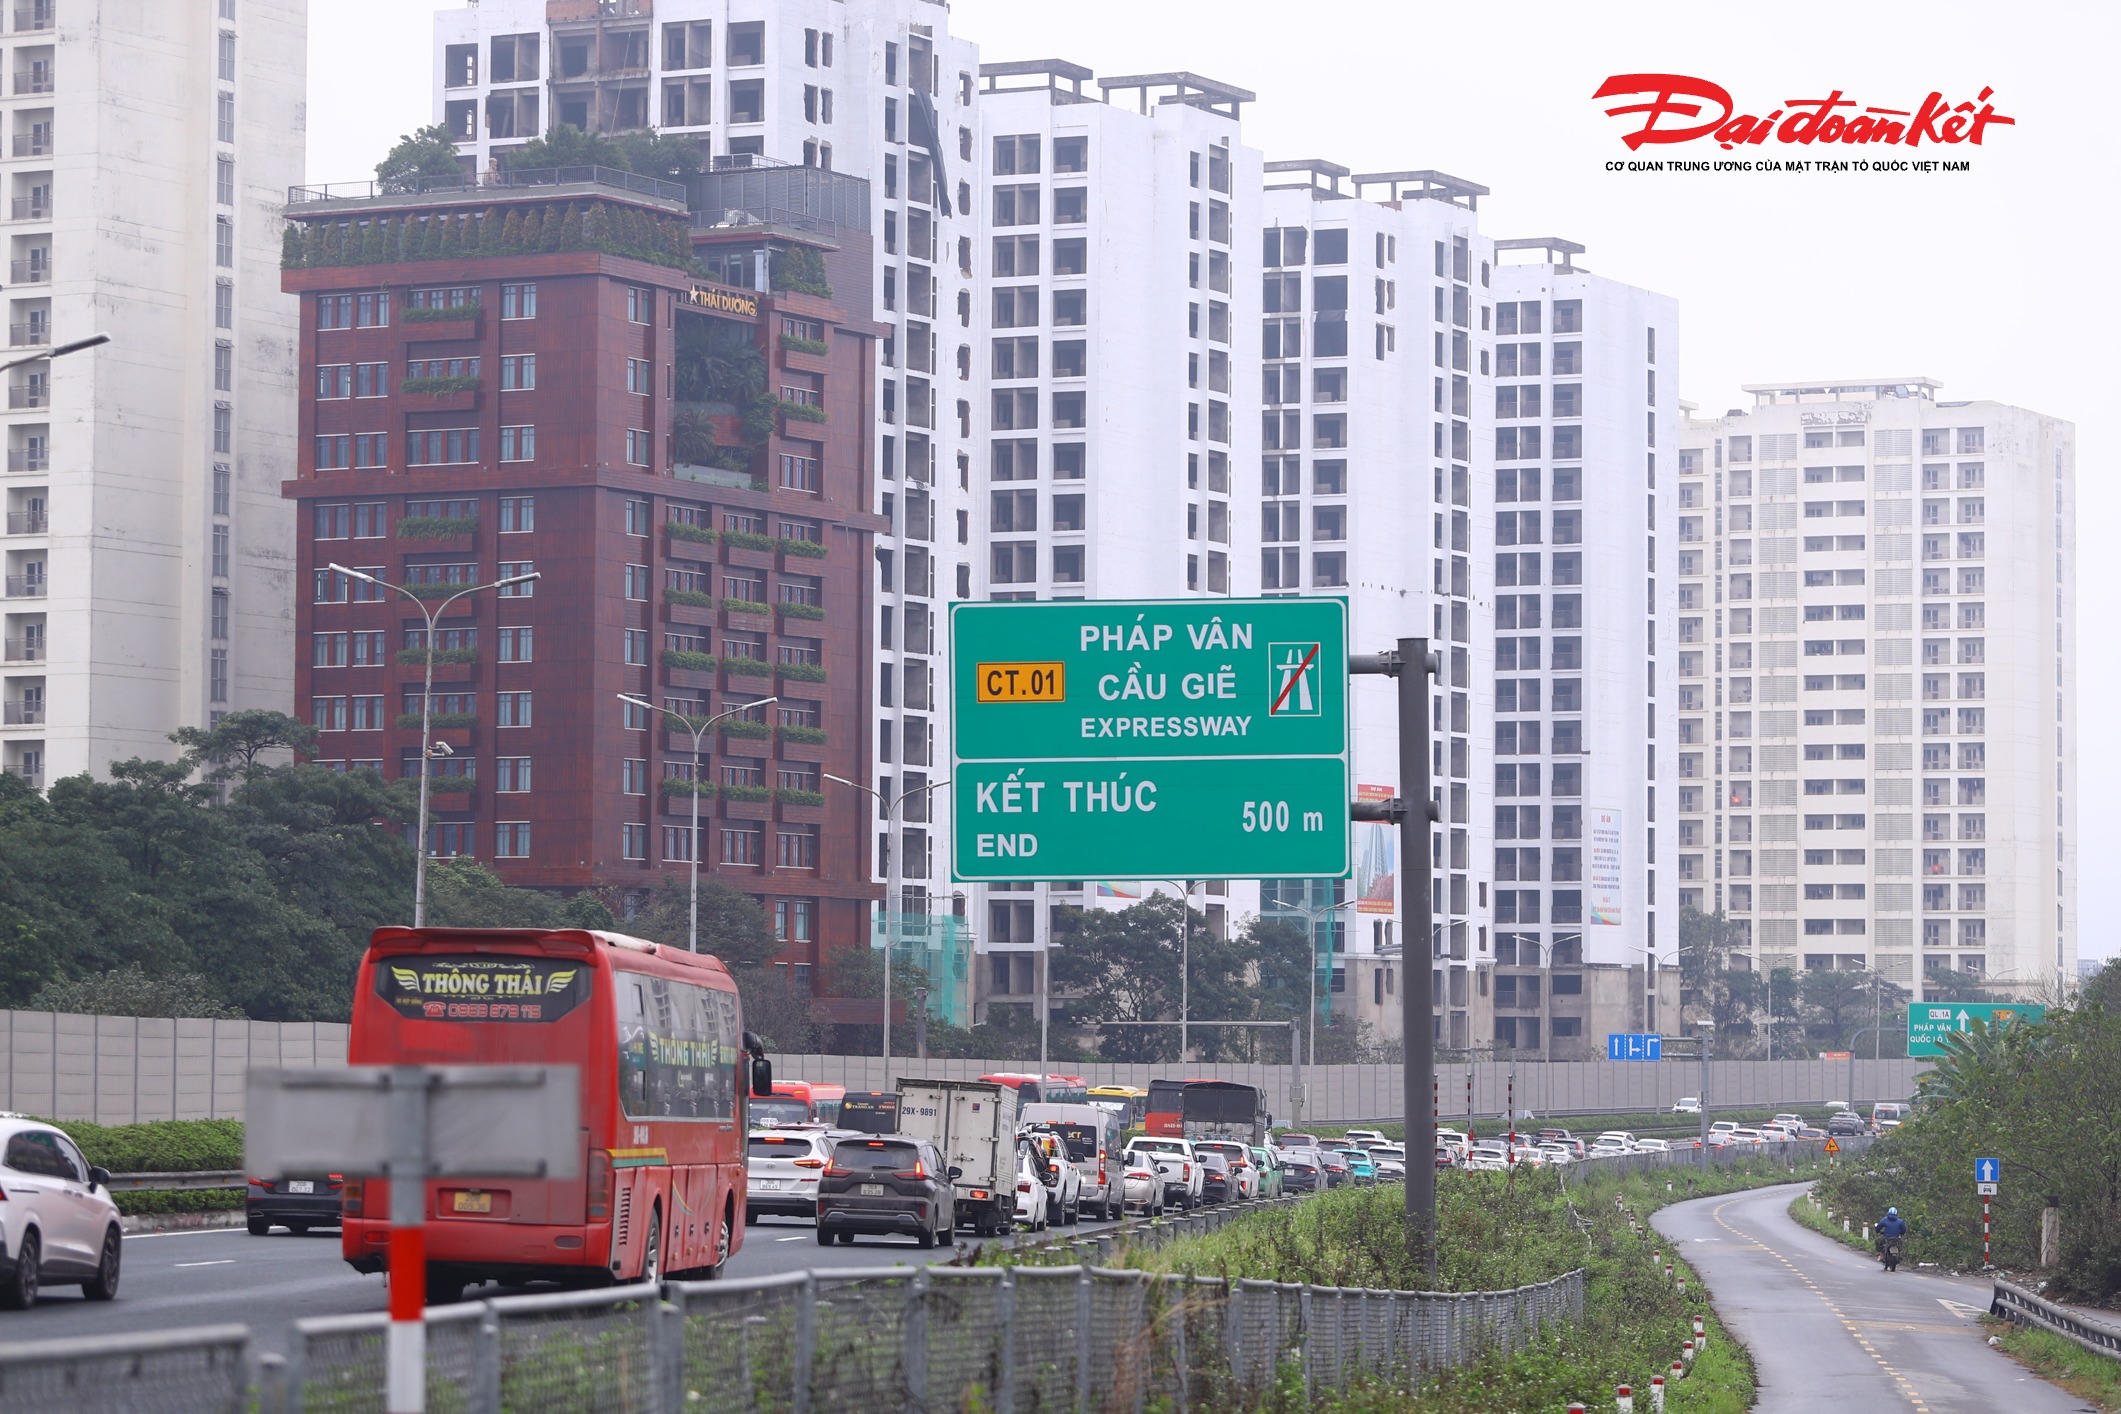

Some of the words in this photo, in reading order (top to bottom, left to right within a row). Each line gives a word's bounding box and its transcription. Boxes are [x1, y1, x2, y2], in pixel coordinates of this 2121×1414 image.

[700, 288, 720, 309] THÁI
[1080, 613, 1173, 652] PHÁP
[1187, 616, 1254, 650] VÂN
[987, 669, 1056, 697] CT.01
[1098, 661, 1167, 701] CẦU
[1182, 665, 1237, 700] GIẼ
[1081, 715, 1252, 738] EXPRESSWAY
[976, 767, 1045, 813] KẾT
[1063, 772, 1158, 813] THÚC
[1242, 800, 1290, 833] 500
[1303, 810, 1324, 832] m
[976, 833, 1039, 858] END
[422, 968, 490, 994] THÔNG
[494, 969, 543, 995] THÁI
[1909, 1033, 1931, 1043] QUỐC
[1914, 1022, 1934, 1031] PHÁP
[660, 1032, 689, 1066] THÔNG
[690, 1035, 711, 1068] THÁI
